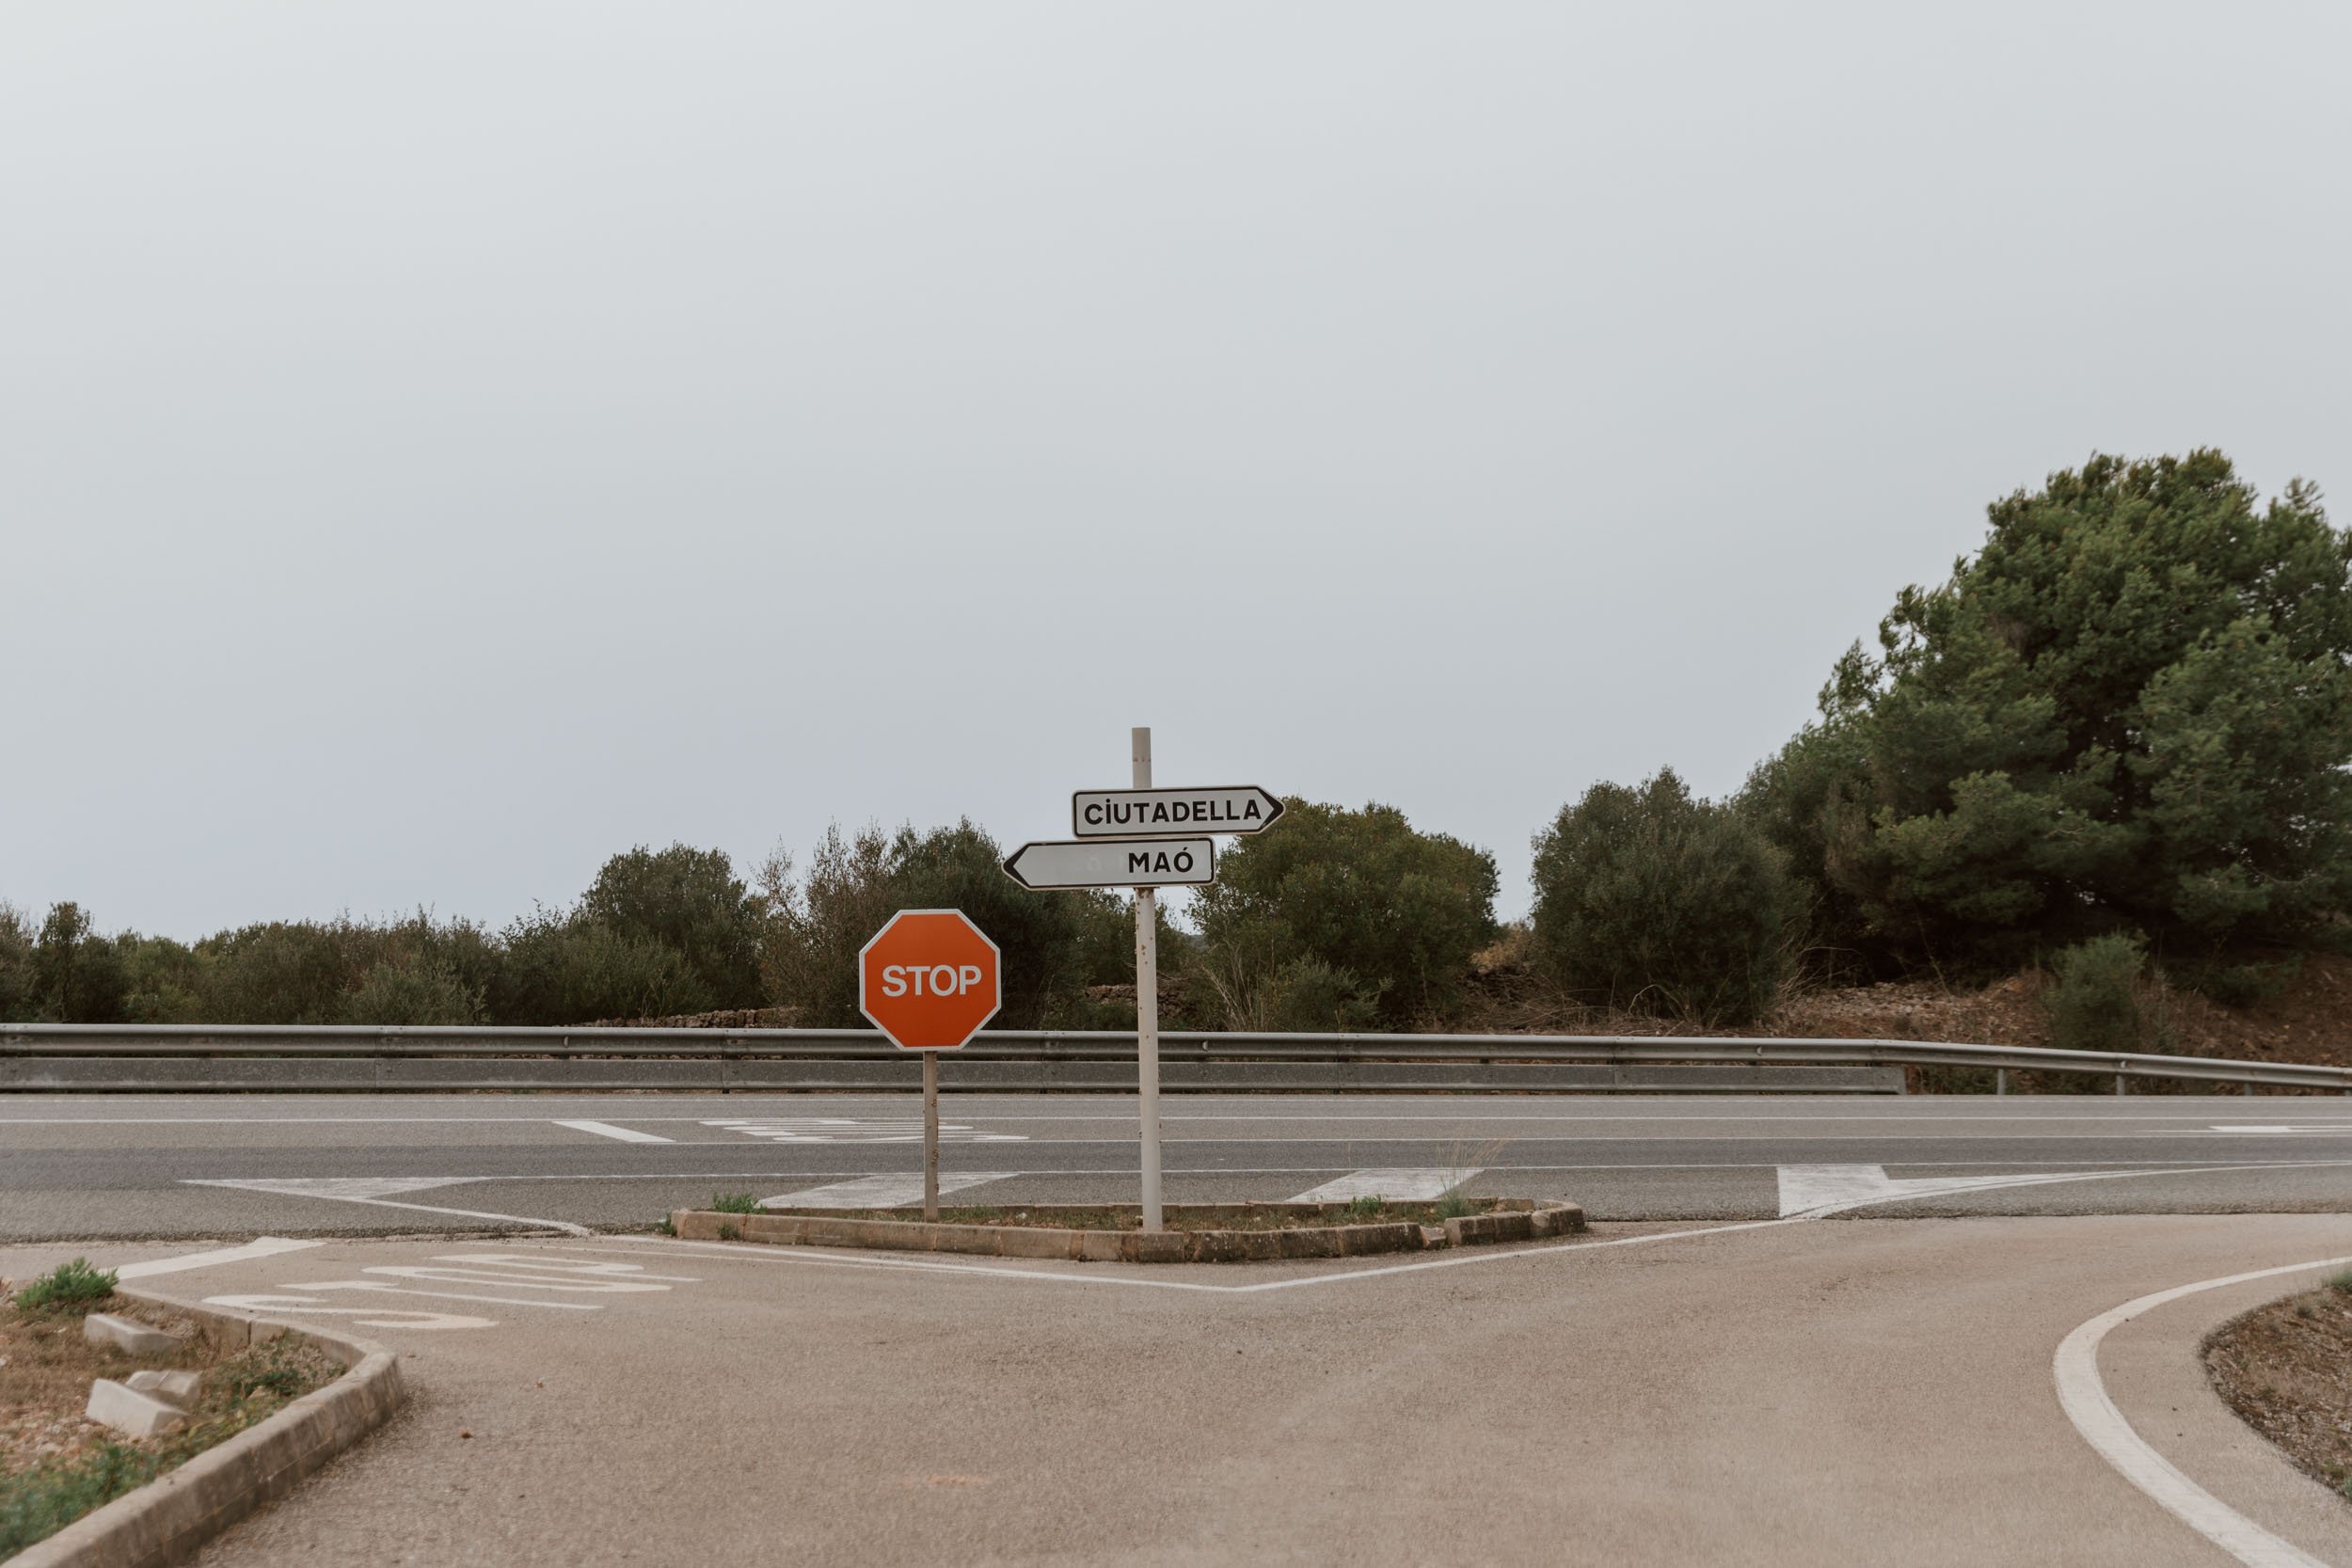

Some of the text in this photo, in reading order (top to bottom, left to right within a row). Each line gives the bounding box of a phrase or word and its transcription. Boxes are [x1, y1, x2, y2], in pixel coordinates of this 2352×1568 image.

[1128, 847, 1194, 873] MAÓ
[882, 964, 982, 997] STOP
[200, 1253, 703, 1329] STOP
